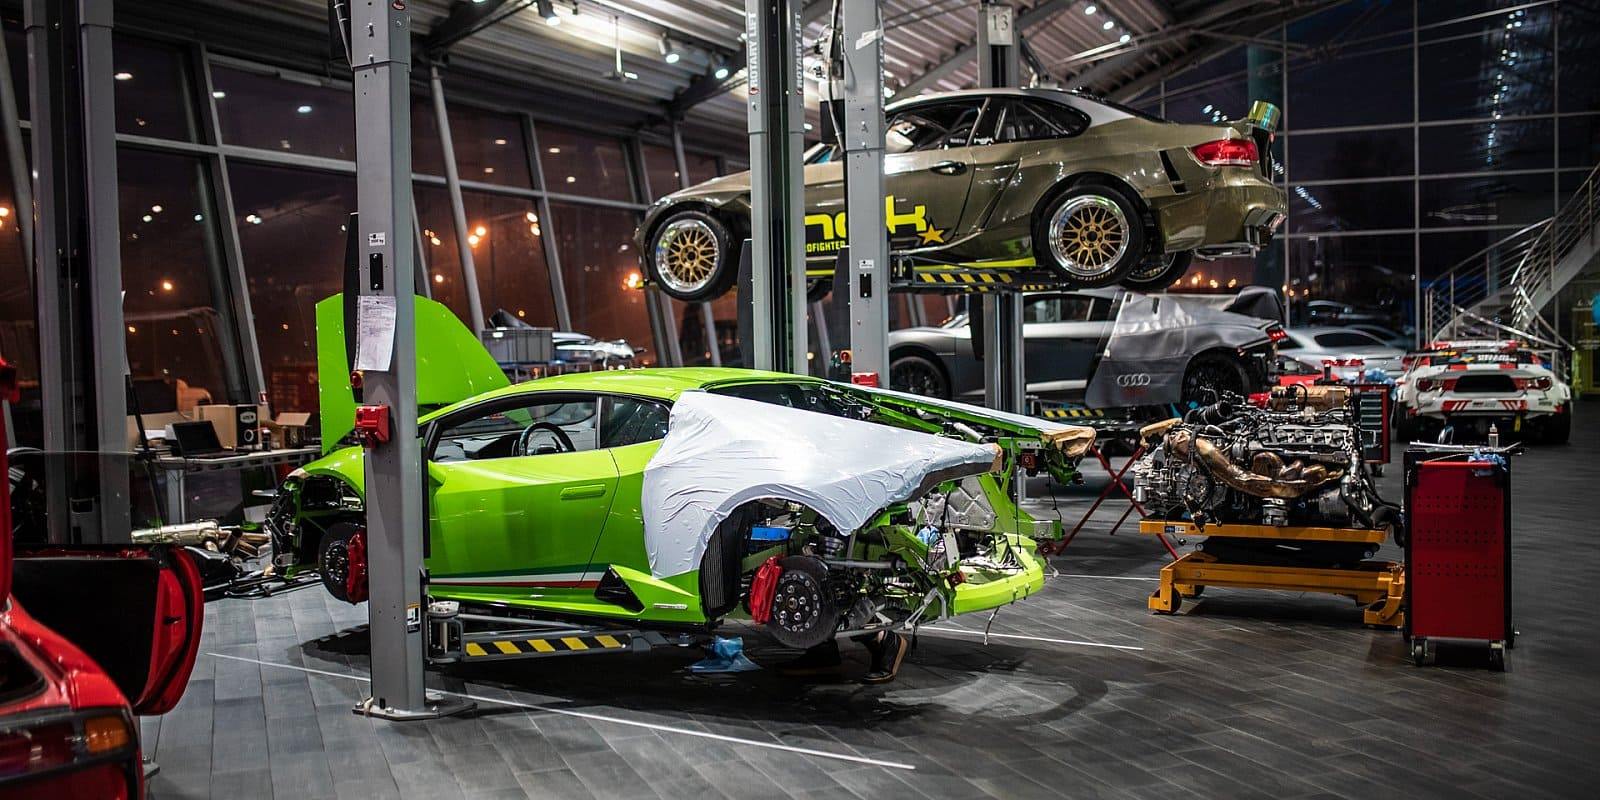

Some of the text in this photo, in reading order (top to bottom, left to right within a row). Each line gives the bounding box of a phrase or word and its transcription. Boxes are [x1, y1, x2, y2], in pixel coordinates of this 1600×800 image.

[992, 14, 1009, 31] 13
[748, 12, 759, 87] ROTARY LIFT
[796, 40, 804, 88] ROTARY
[805, 240, 846, 253] OFIGHTER
